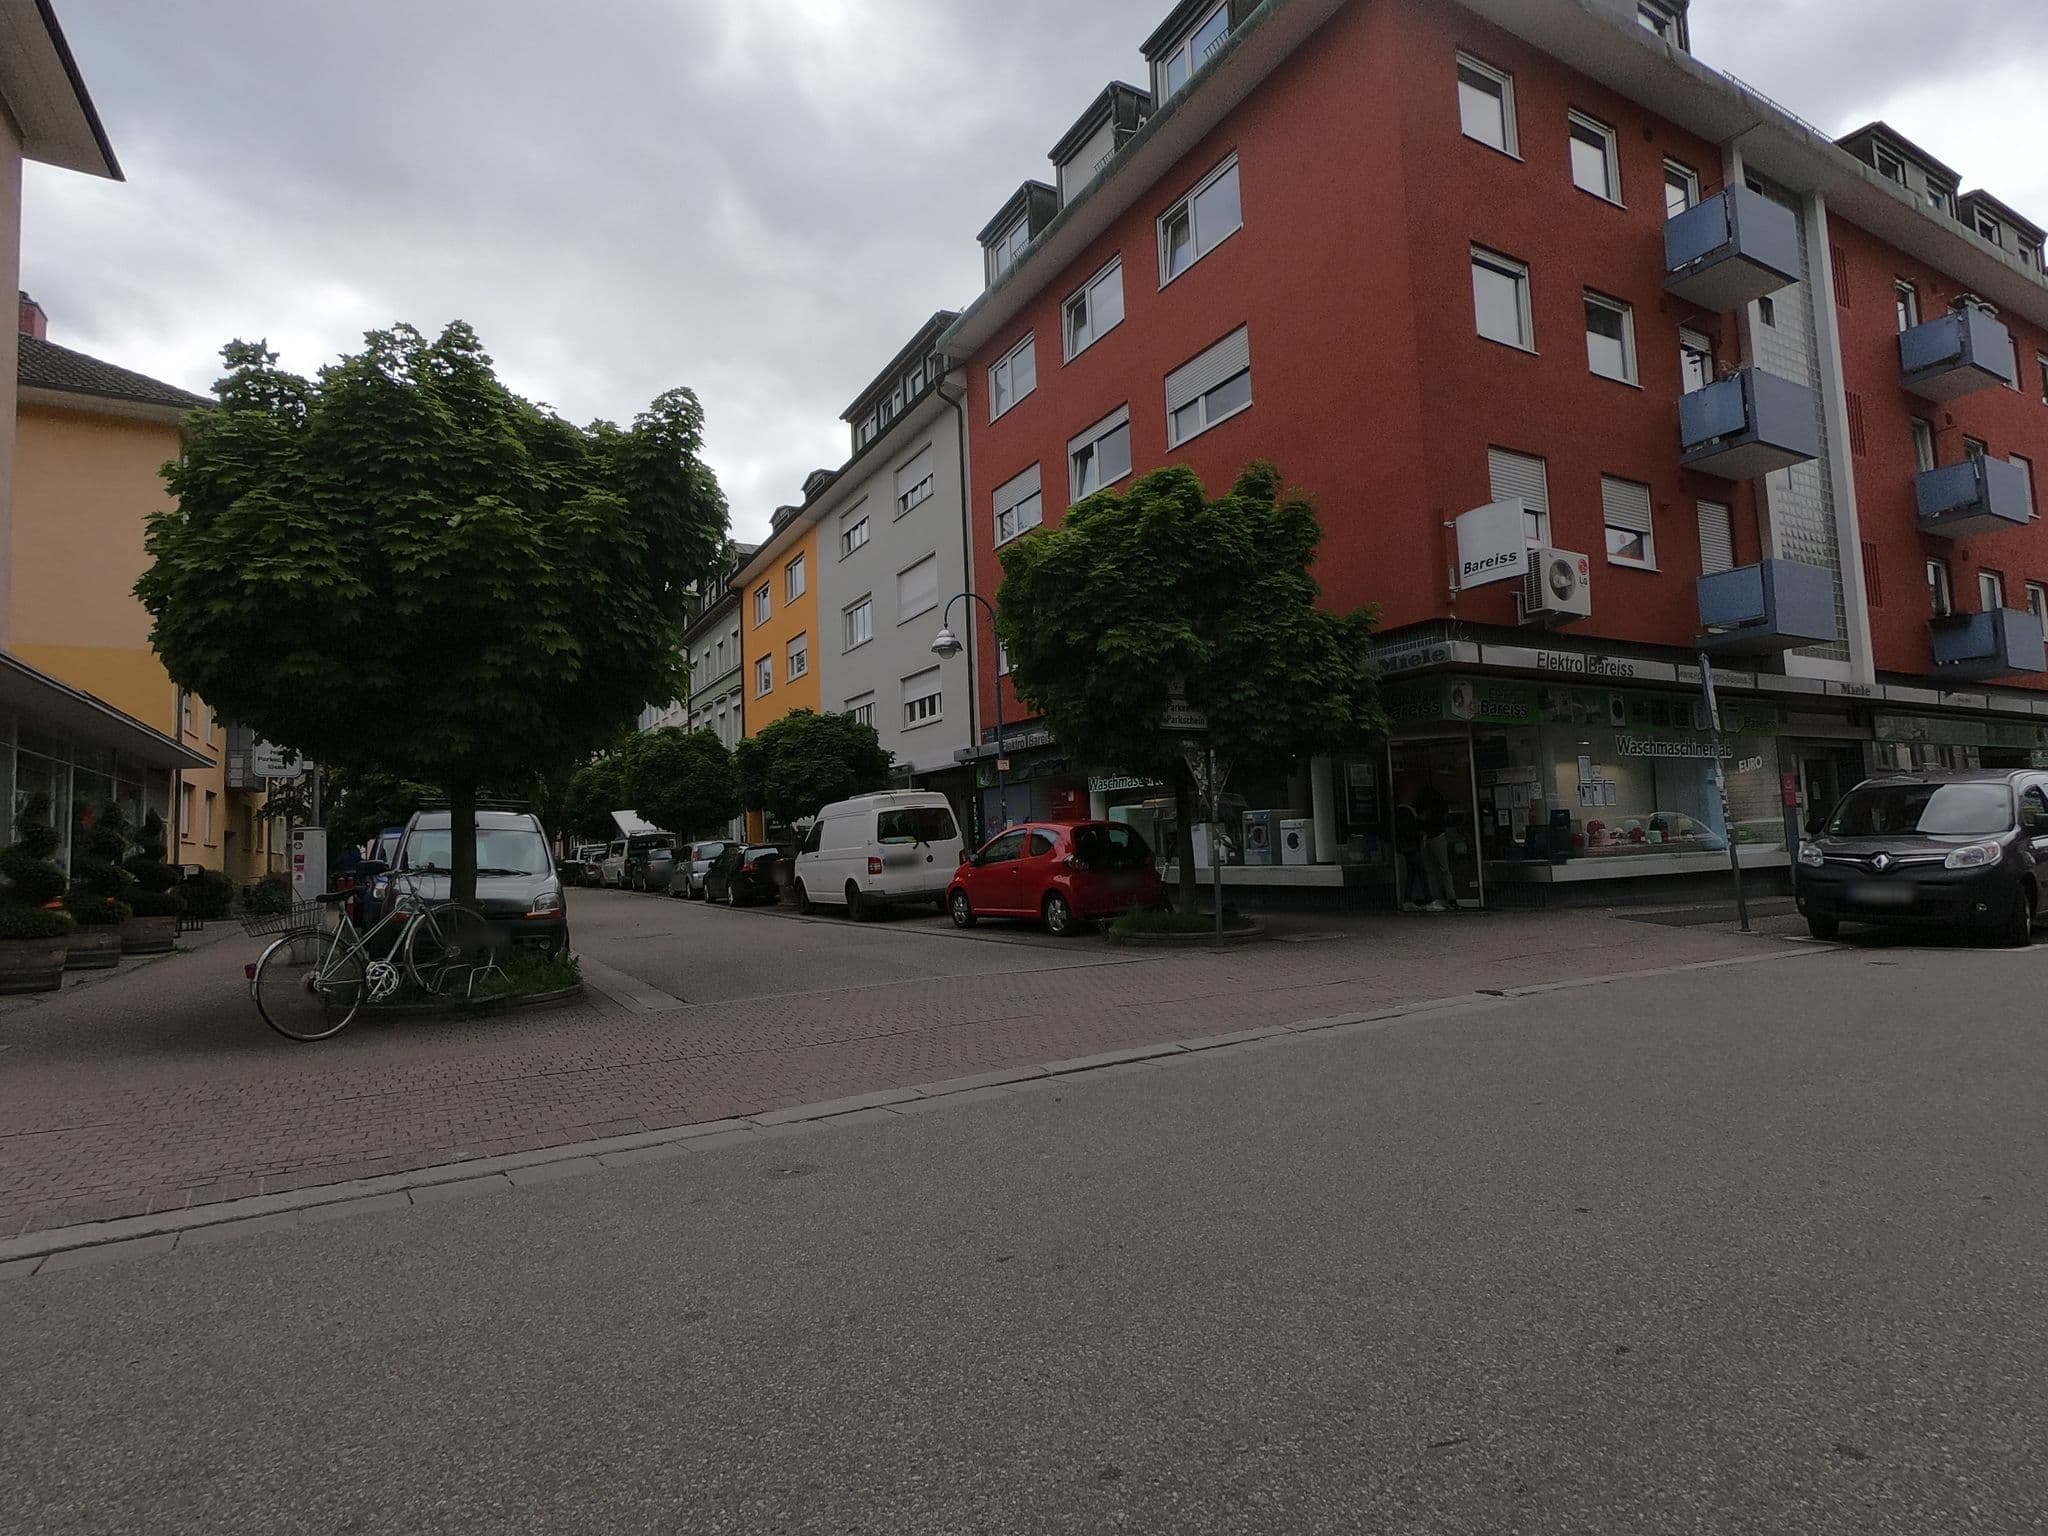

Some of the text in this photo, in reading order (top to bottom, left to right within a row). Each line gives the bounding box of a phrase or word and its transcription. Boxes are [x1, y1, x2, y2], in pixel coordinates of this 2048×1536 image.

[1463, 552, 1518, 575] Bareiss
[1579, 576, 1588, 586] LG
[1537, 651, 1634, 676] Elektro Bareiss
[1841, 684, 1871, 696] Miele
[1388, 702, 1440, 719] areiss
[1480, 700, 1528, 716] Bareiss
[1719, 738, 1734, 758] ab
[1738, 756, 1763, 774] EURO
